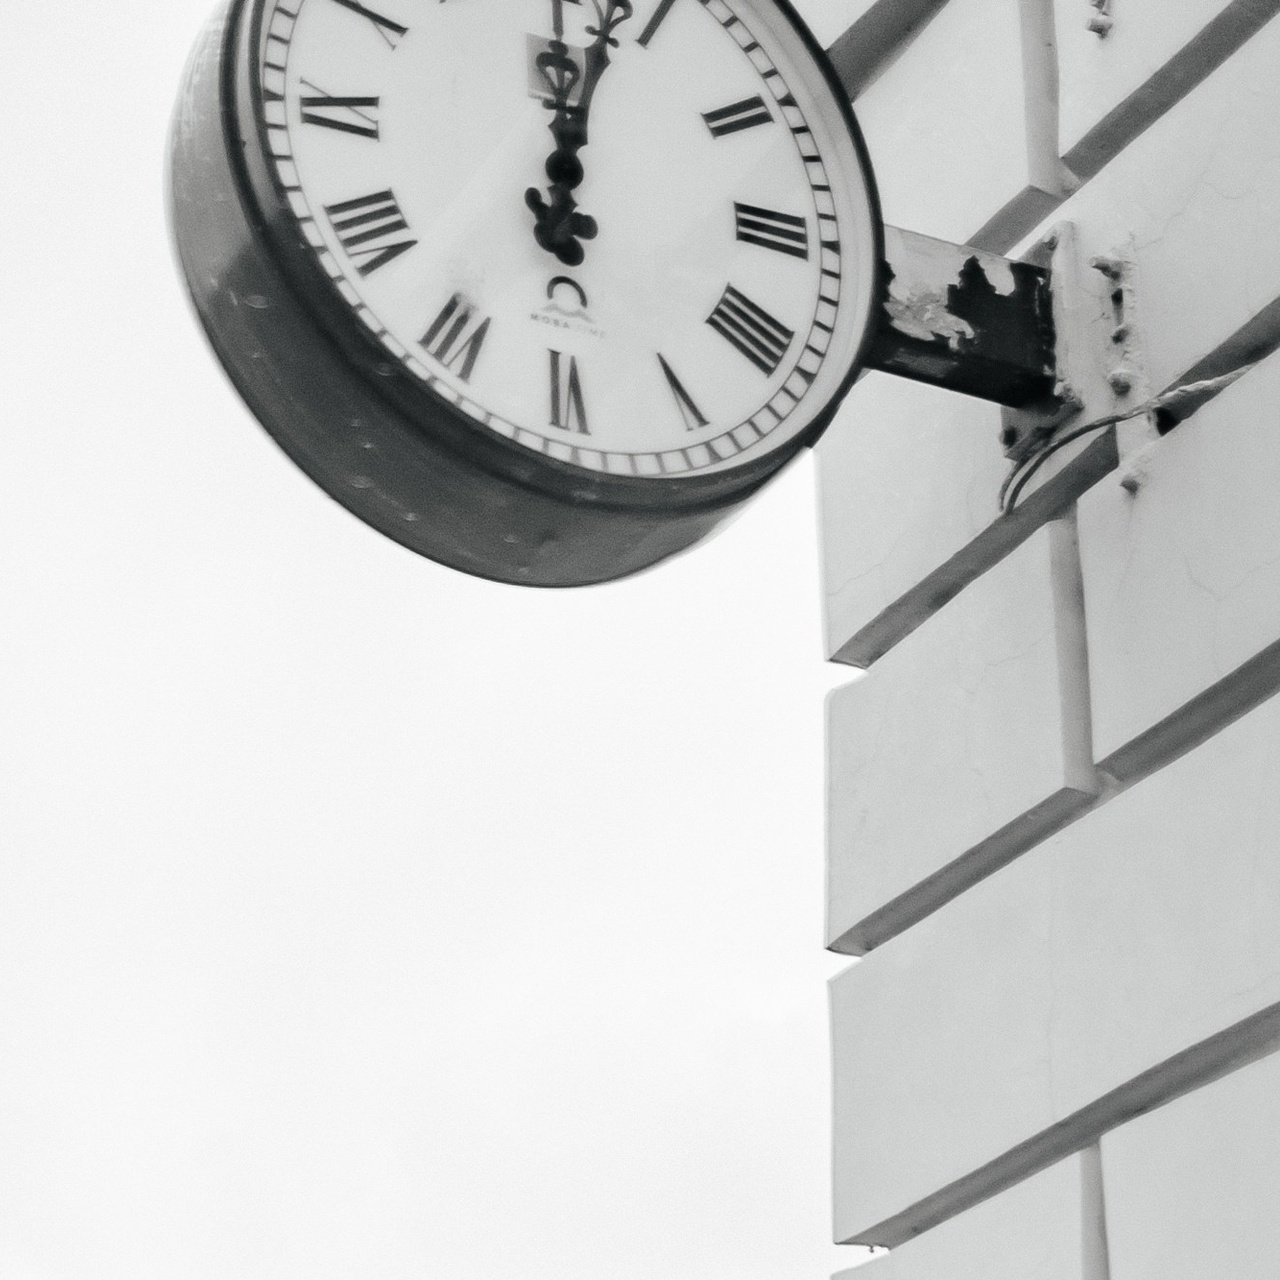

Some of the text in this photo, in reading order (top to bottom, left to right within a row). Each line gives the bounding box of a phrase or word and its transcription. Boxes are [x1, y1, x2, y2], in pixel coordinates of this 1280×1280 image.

[700, 93, 775, 140] II
[323, 188, 418, 279] VIII
[733, 201, 809, 262] III
[417, 291, 491, 383] VII
[705, 282, 795, 379] IIII
[548, 348, 591, 435] VI
[656, 352, 711, 431] V
